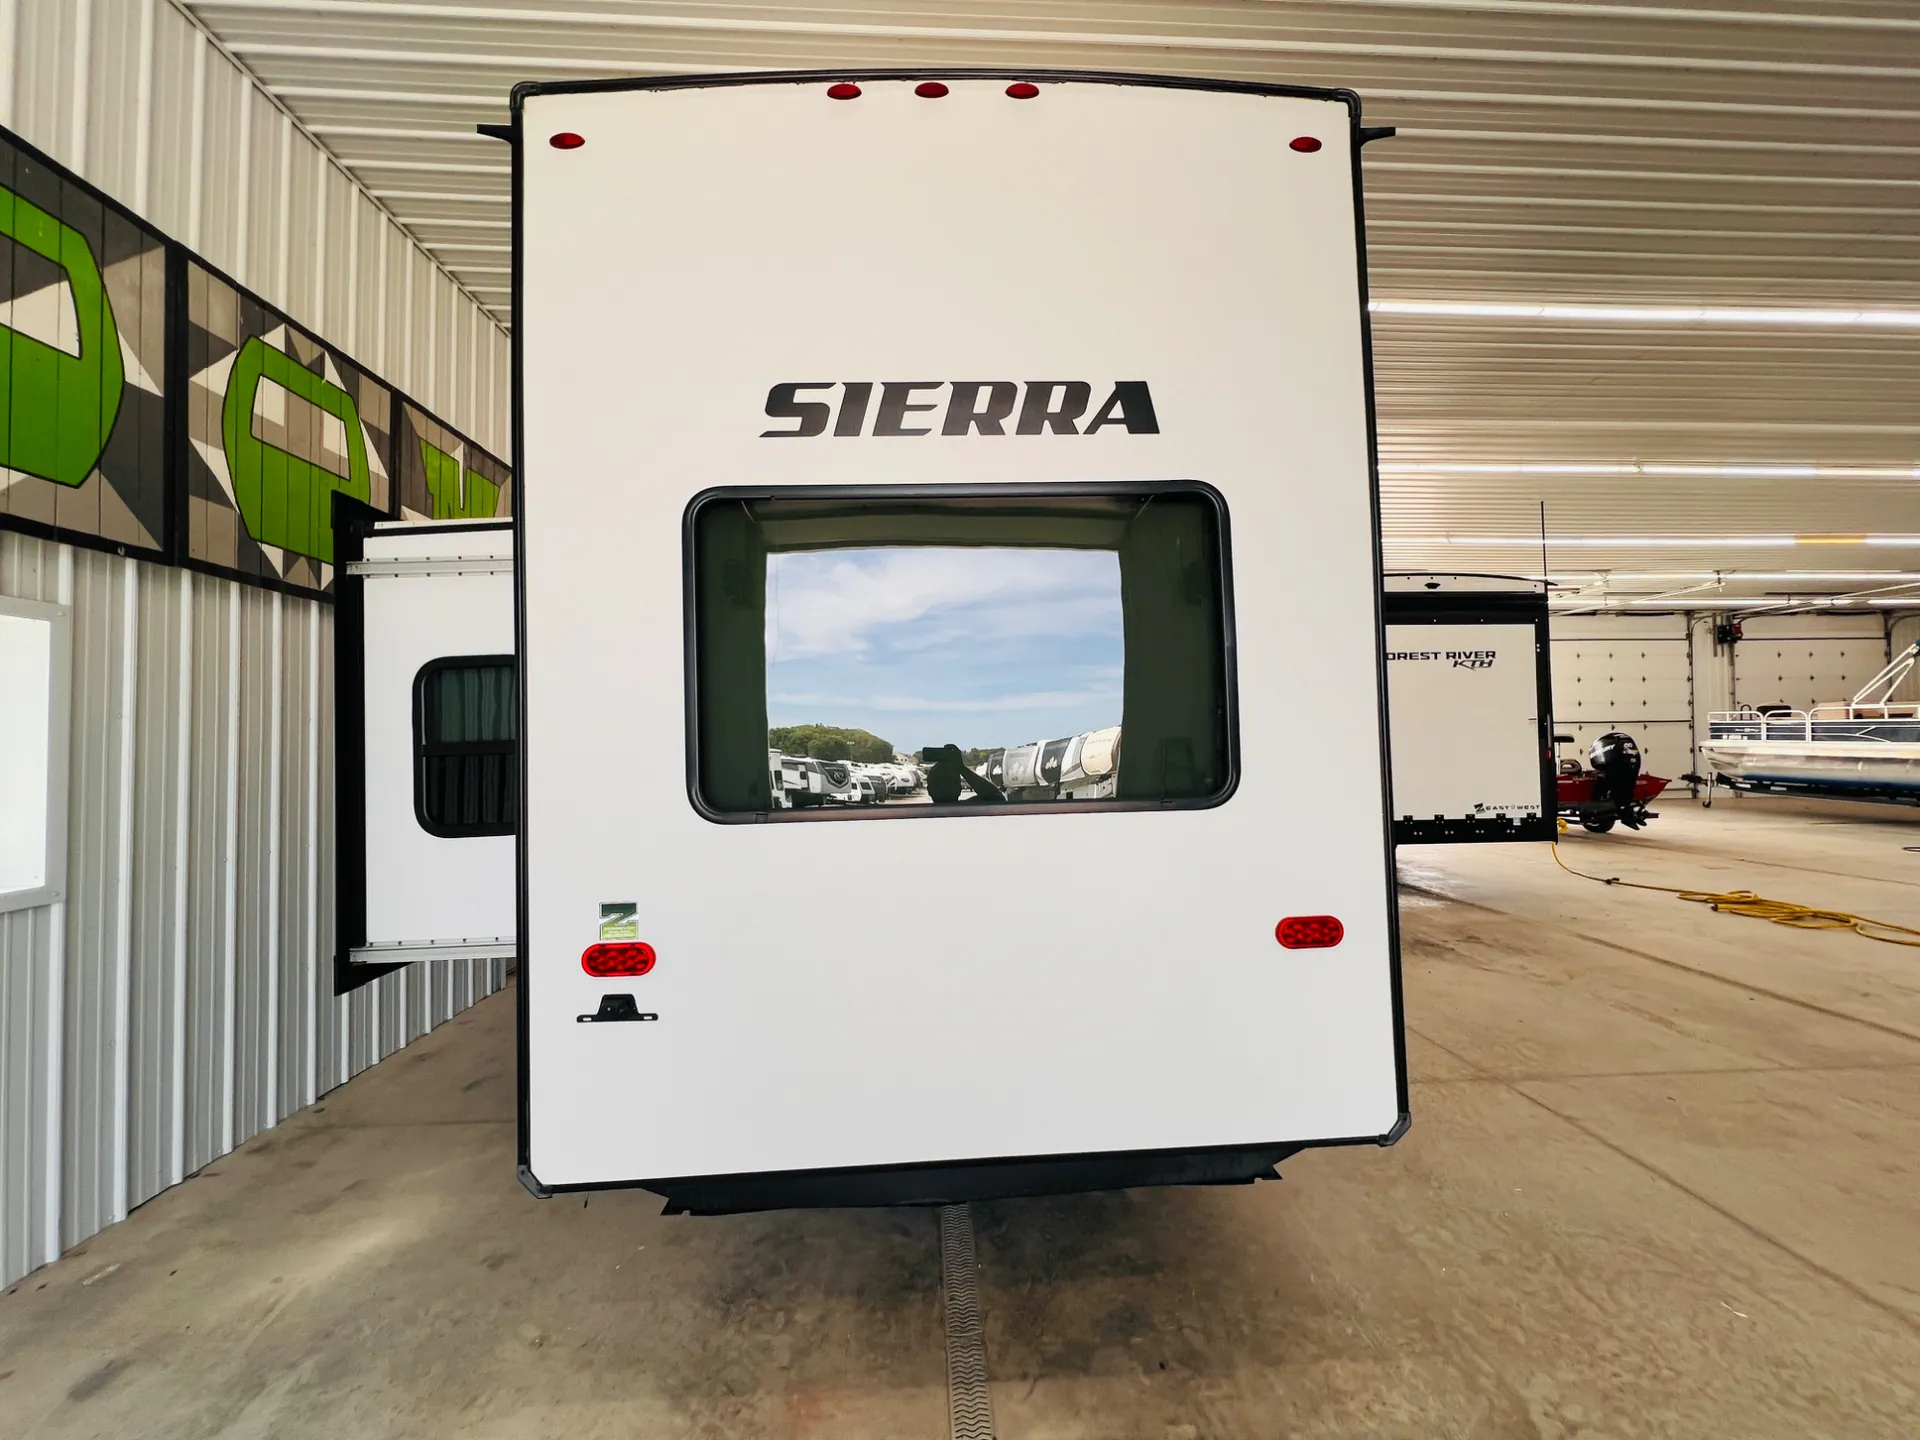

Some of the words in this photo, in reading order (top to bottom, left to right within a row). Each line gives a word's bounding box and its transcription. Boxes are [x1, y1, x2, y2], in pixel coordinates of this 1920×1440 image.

[759, 381, 1160, 437] SIERRA
[1387, 652, 1441, 660] OREST
[1445, 651, 1496, 659] RIVER
